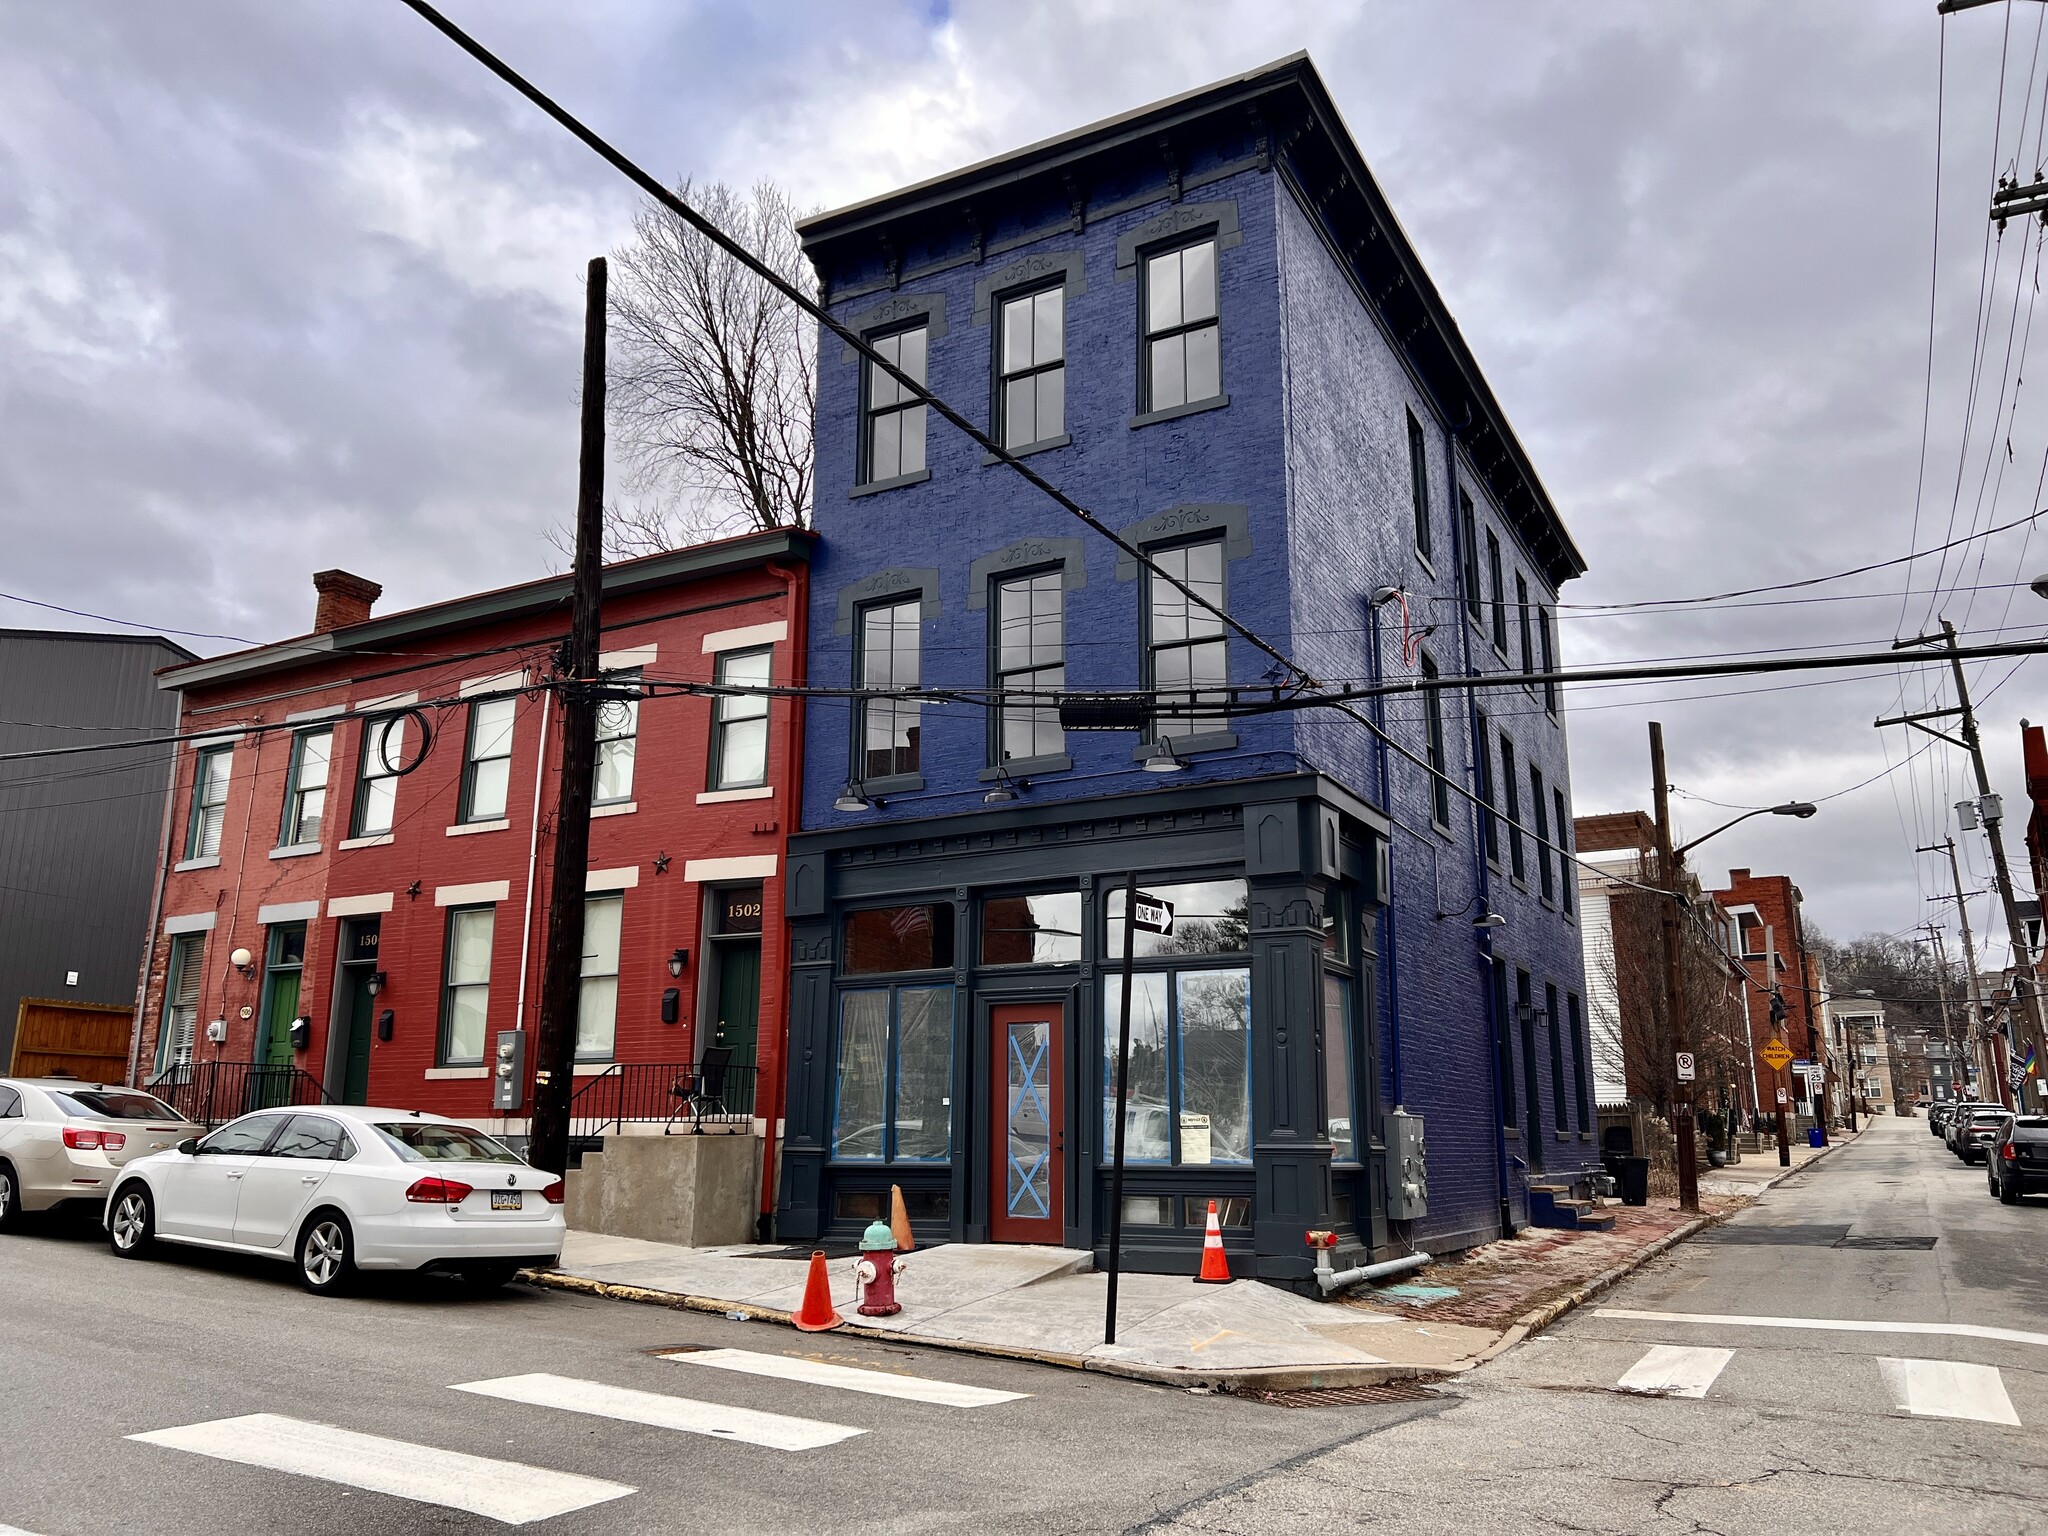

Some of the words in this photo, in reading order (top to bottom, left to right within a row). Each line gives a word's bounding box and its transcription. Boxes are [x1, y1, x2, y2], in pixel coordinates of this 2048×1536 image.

[728, 903, 761, 917] 1502
[1138, 905, 1149, 921] ONE
[1150, 908, 1163, 923] WAY
[360, 934, 380, 946] 150
